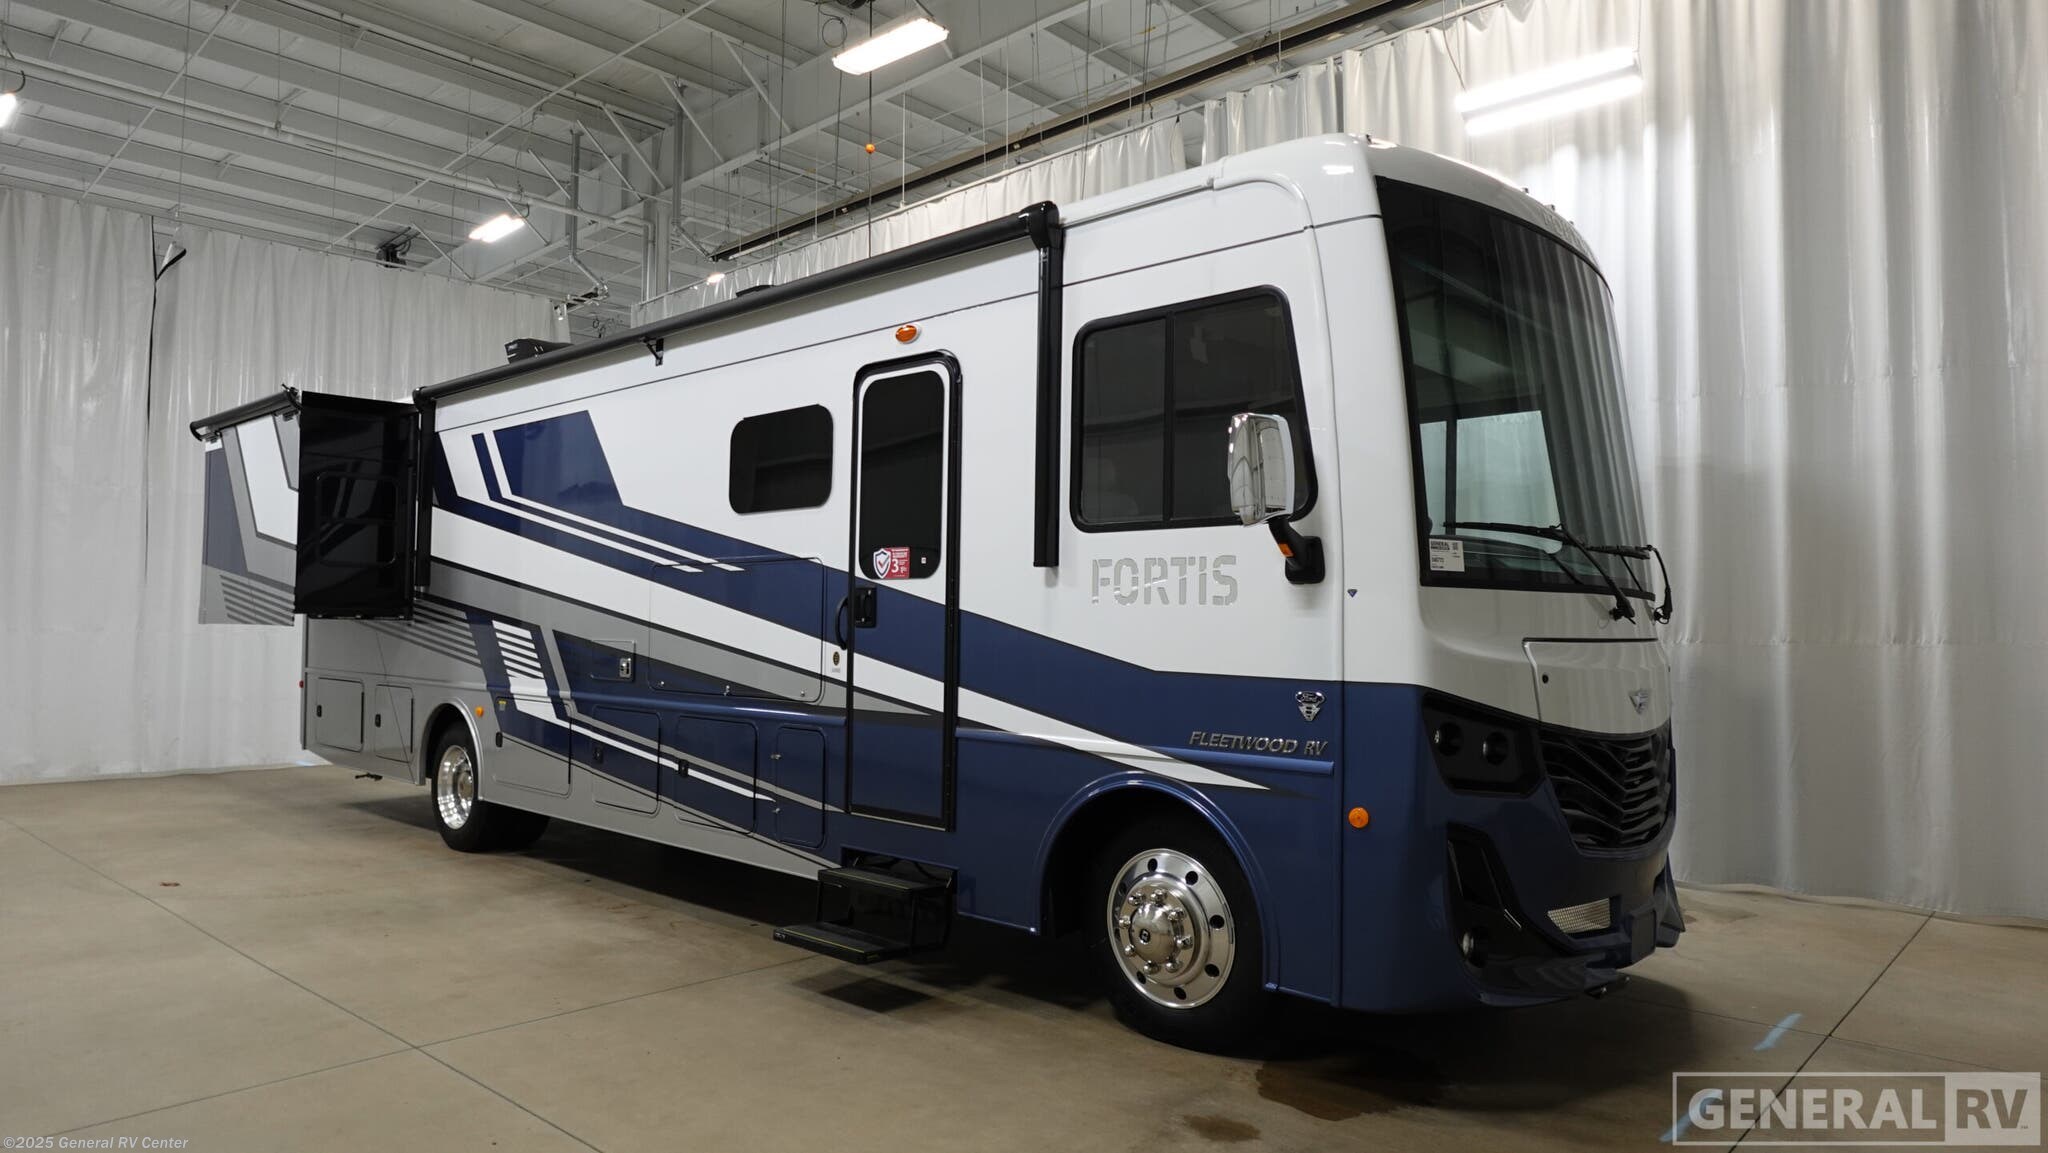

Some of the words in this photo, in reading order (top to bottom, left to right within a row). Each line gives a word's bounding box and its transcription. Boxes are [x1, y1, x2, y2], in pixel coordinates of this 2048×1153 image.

[891, 558, 899, 573] 3
[1091, 554, 1239, 606] FORTIS
[1188, 731, 1298, 754] FLEETWOOD
[1303, 740, 1329, 757] RV
